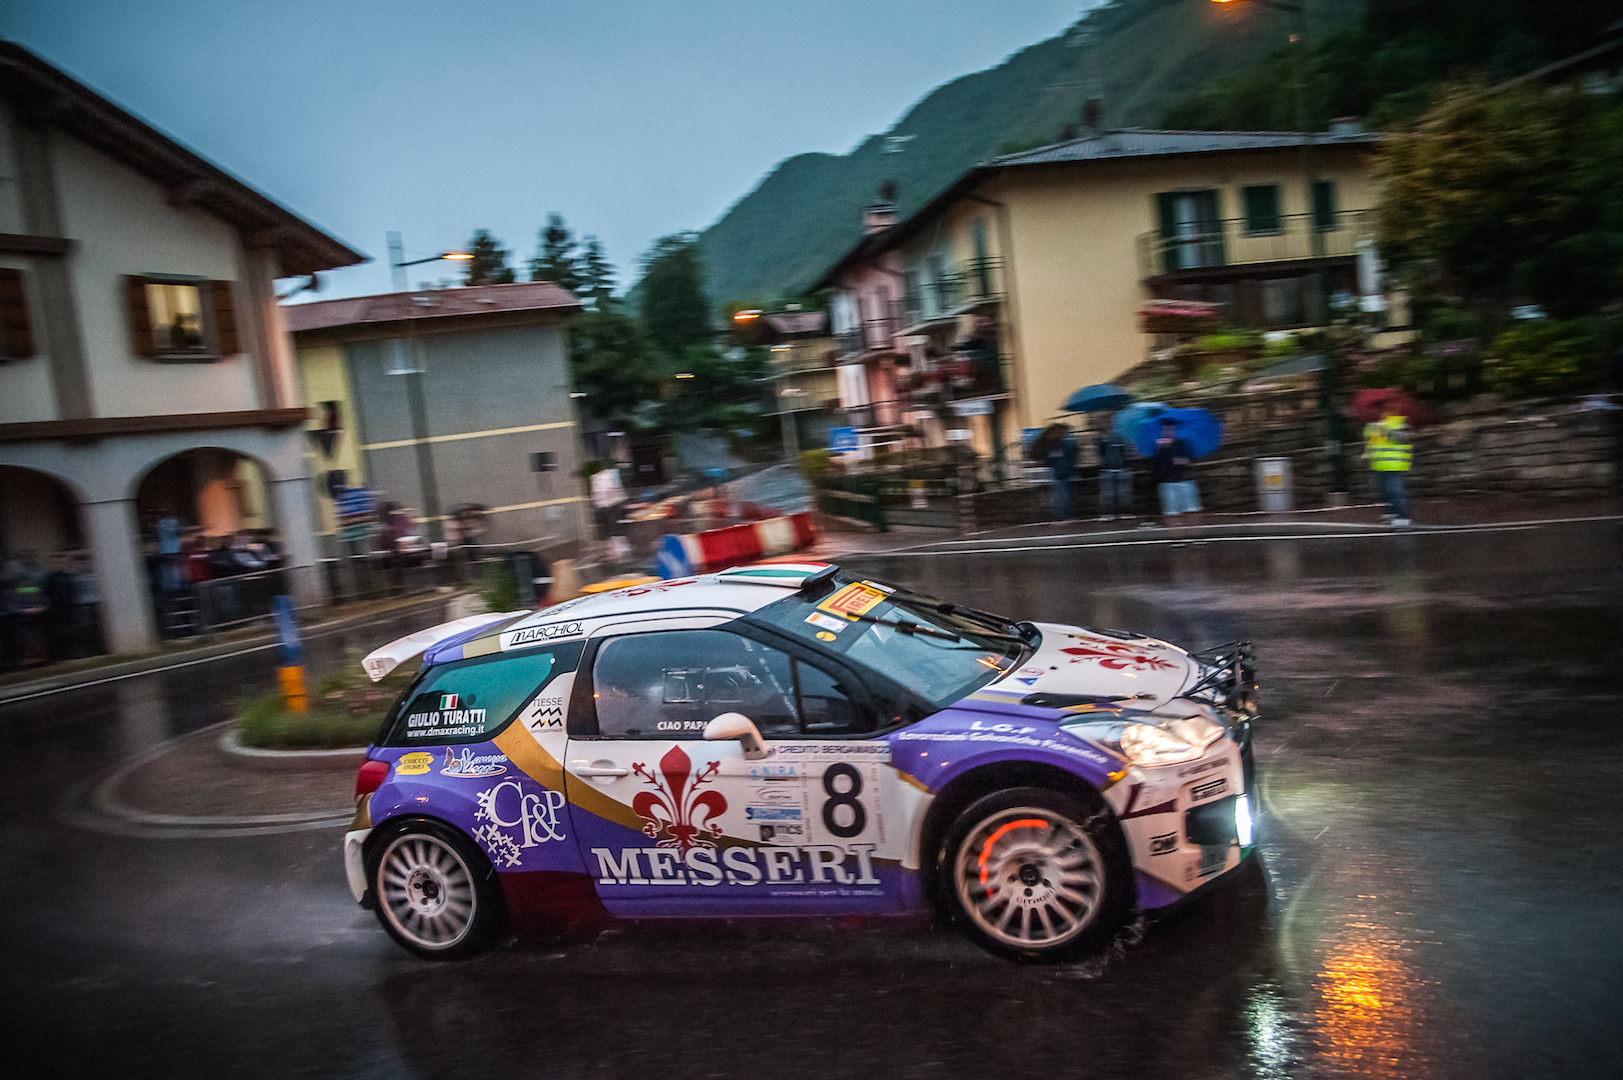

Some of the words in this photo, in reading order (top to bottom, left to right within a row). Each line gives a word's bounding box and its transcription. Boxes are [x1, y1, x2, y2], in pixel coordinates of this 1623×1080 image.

[510, 622, 584, 643] MARCHIOL
[533, 697, 563, 707] TIESSE
[407, 711, 440, 728] GIULIO
[443, 709, 487, 726] TURATTI
[657, 721, 682, 731] CIAO
[406, 724, 485, 738] www.dmaxracing.it
[822, 762, 867, 838] 8
[591, 843, 882, 887] MESSERI
